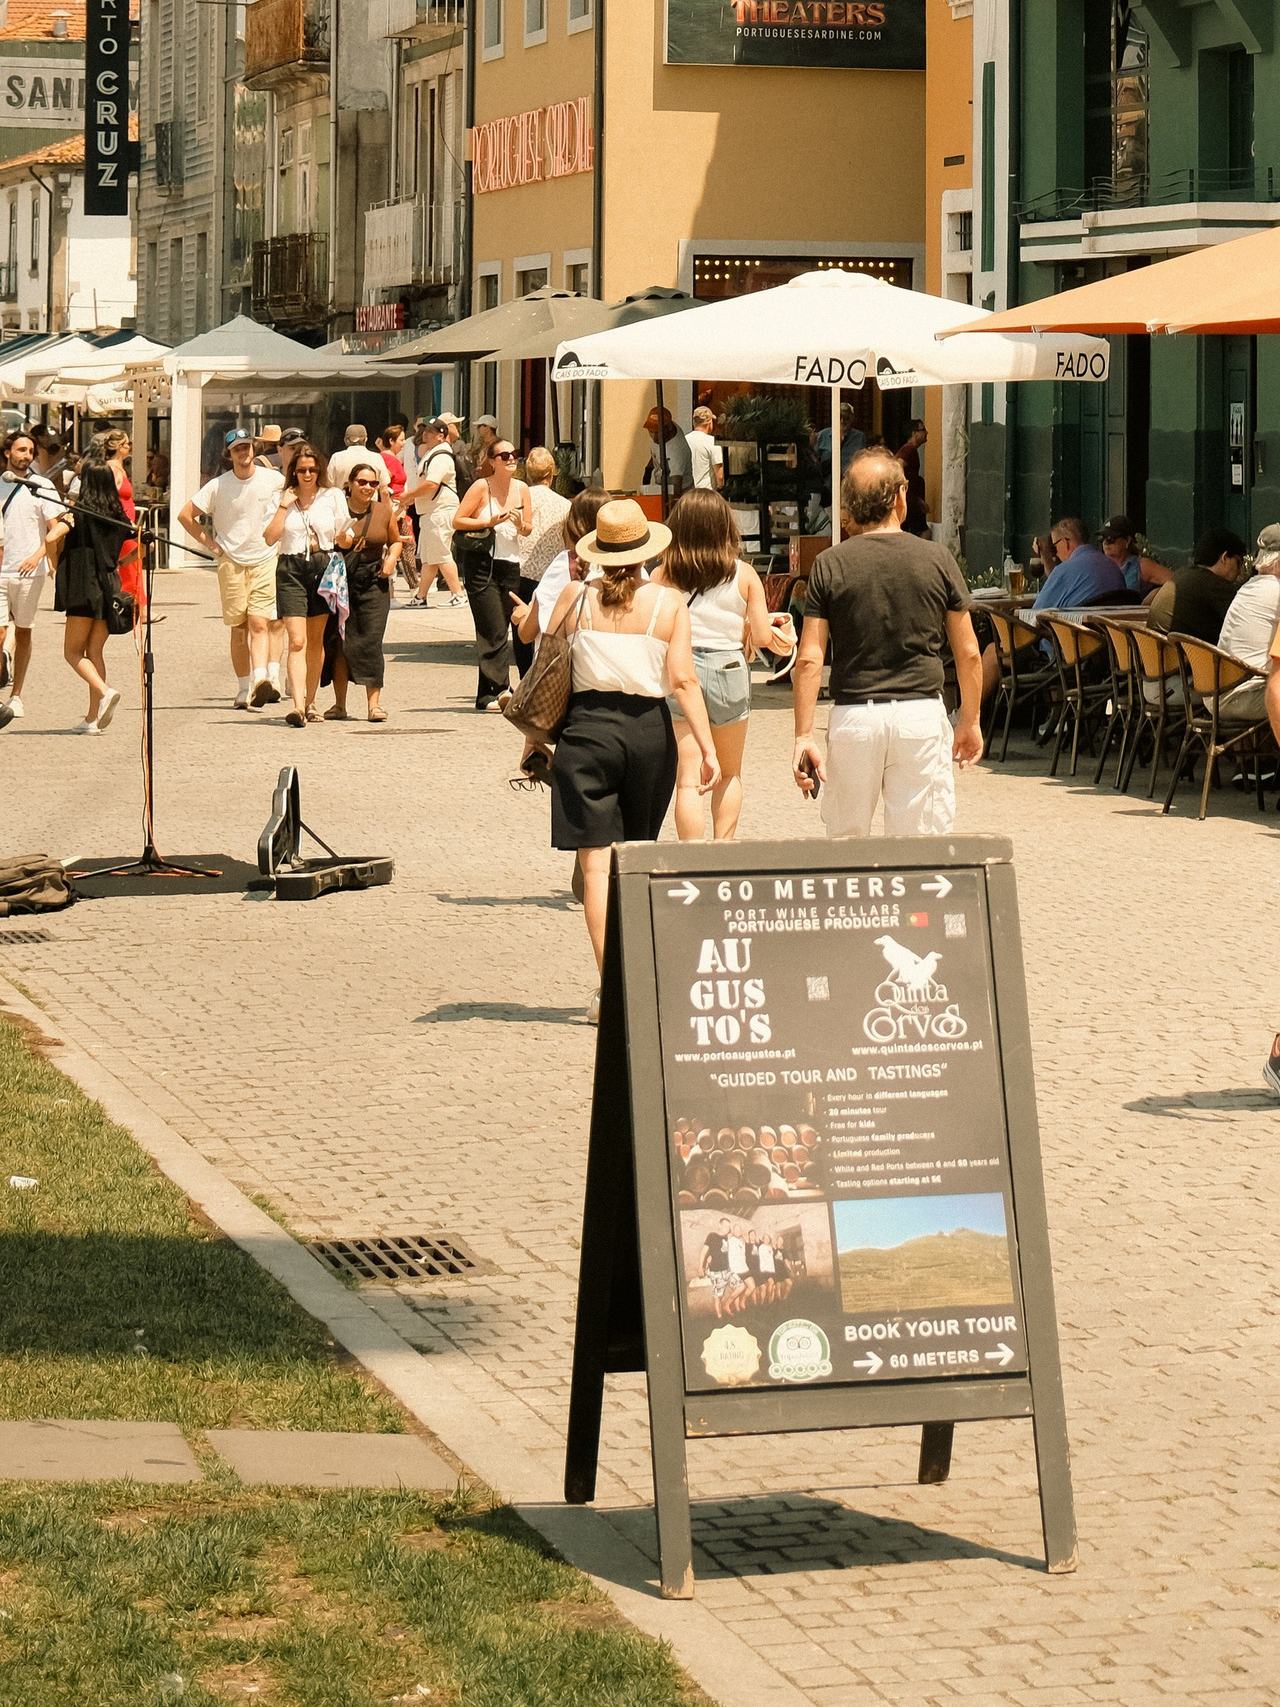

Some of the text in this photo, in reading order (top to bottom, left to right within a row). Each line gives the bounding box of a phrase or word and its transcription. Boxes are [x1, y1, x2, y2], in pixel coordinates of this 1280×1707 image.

[730, 0, 886, 26] THEATERS
[736, 27, 882, 40] PORTUGUESESARDINE.COM
[96, 70, 119, 187] CRUZ
[555, 369, 608, 379] CAIS DO FADO
[794, 355, 867, 386] FADO
[1055, 351, 1106, 379] FADO
[717, 876, 906, 902] 60 METERS
[723, 903, 900, 921] PORT WINE CELLARS
[728, 915, 900, 933] PORTUGUESE PRODUCER
[696, 938, 752, 974] AU
[690, 977, 766, 1011] GUS
[690, 1010, 772, 1046] TO'S
[675, 1047, 796, 1062] www.portoaugustos.pt
[851, 1039, 984, 1056] www.quintadoscorvos.pt
[780, 1068, 822, 1085] TOUR
[826, 1066, 858, 1083] AND
[827, 1089, 948, 1102] Every hour in different languages
[840, 1106, 872, 1116] minutes
[872, 1106, 887, 1114] tour
[830, 1121, 846, 1129] Free
[858, 1120, 876, 1128] kids
[832, 1131, 935, 1144] Portuguese family producers
[833, 1147, 901, 1158] Limited production
[835, 1164, 855, 1173] White
[856, 1163, 870, 1172] and
[871, 1163, 885, 1171] Red
[886, 1162, 904, 1170] Ports
[905, 1160, 934, 1170] between
[942, 1159, 956, 1168] and
[969, 1158, 988, 1167] years
[989, 1157, 1000, 1165] old
[835, 1179, 861, 1188] Tasting
[862, 1178, 888, 1187] options
[889, 1175, 920, 1186] starting
[921, 1175, 930, 1184] at
[844, 1322, 901, 1342] BOOK
[905, 1319, 960, 1338] YOUR
[965, 1315, 1017, 1335] TOUR
[889, 1350, 980, 1368] 60 METERS
